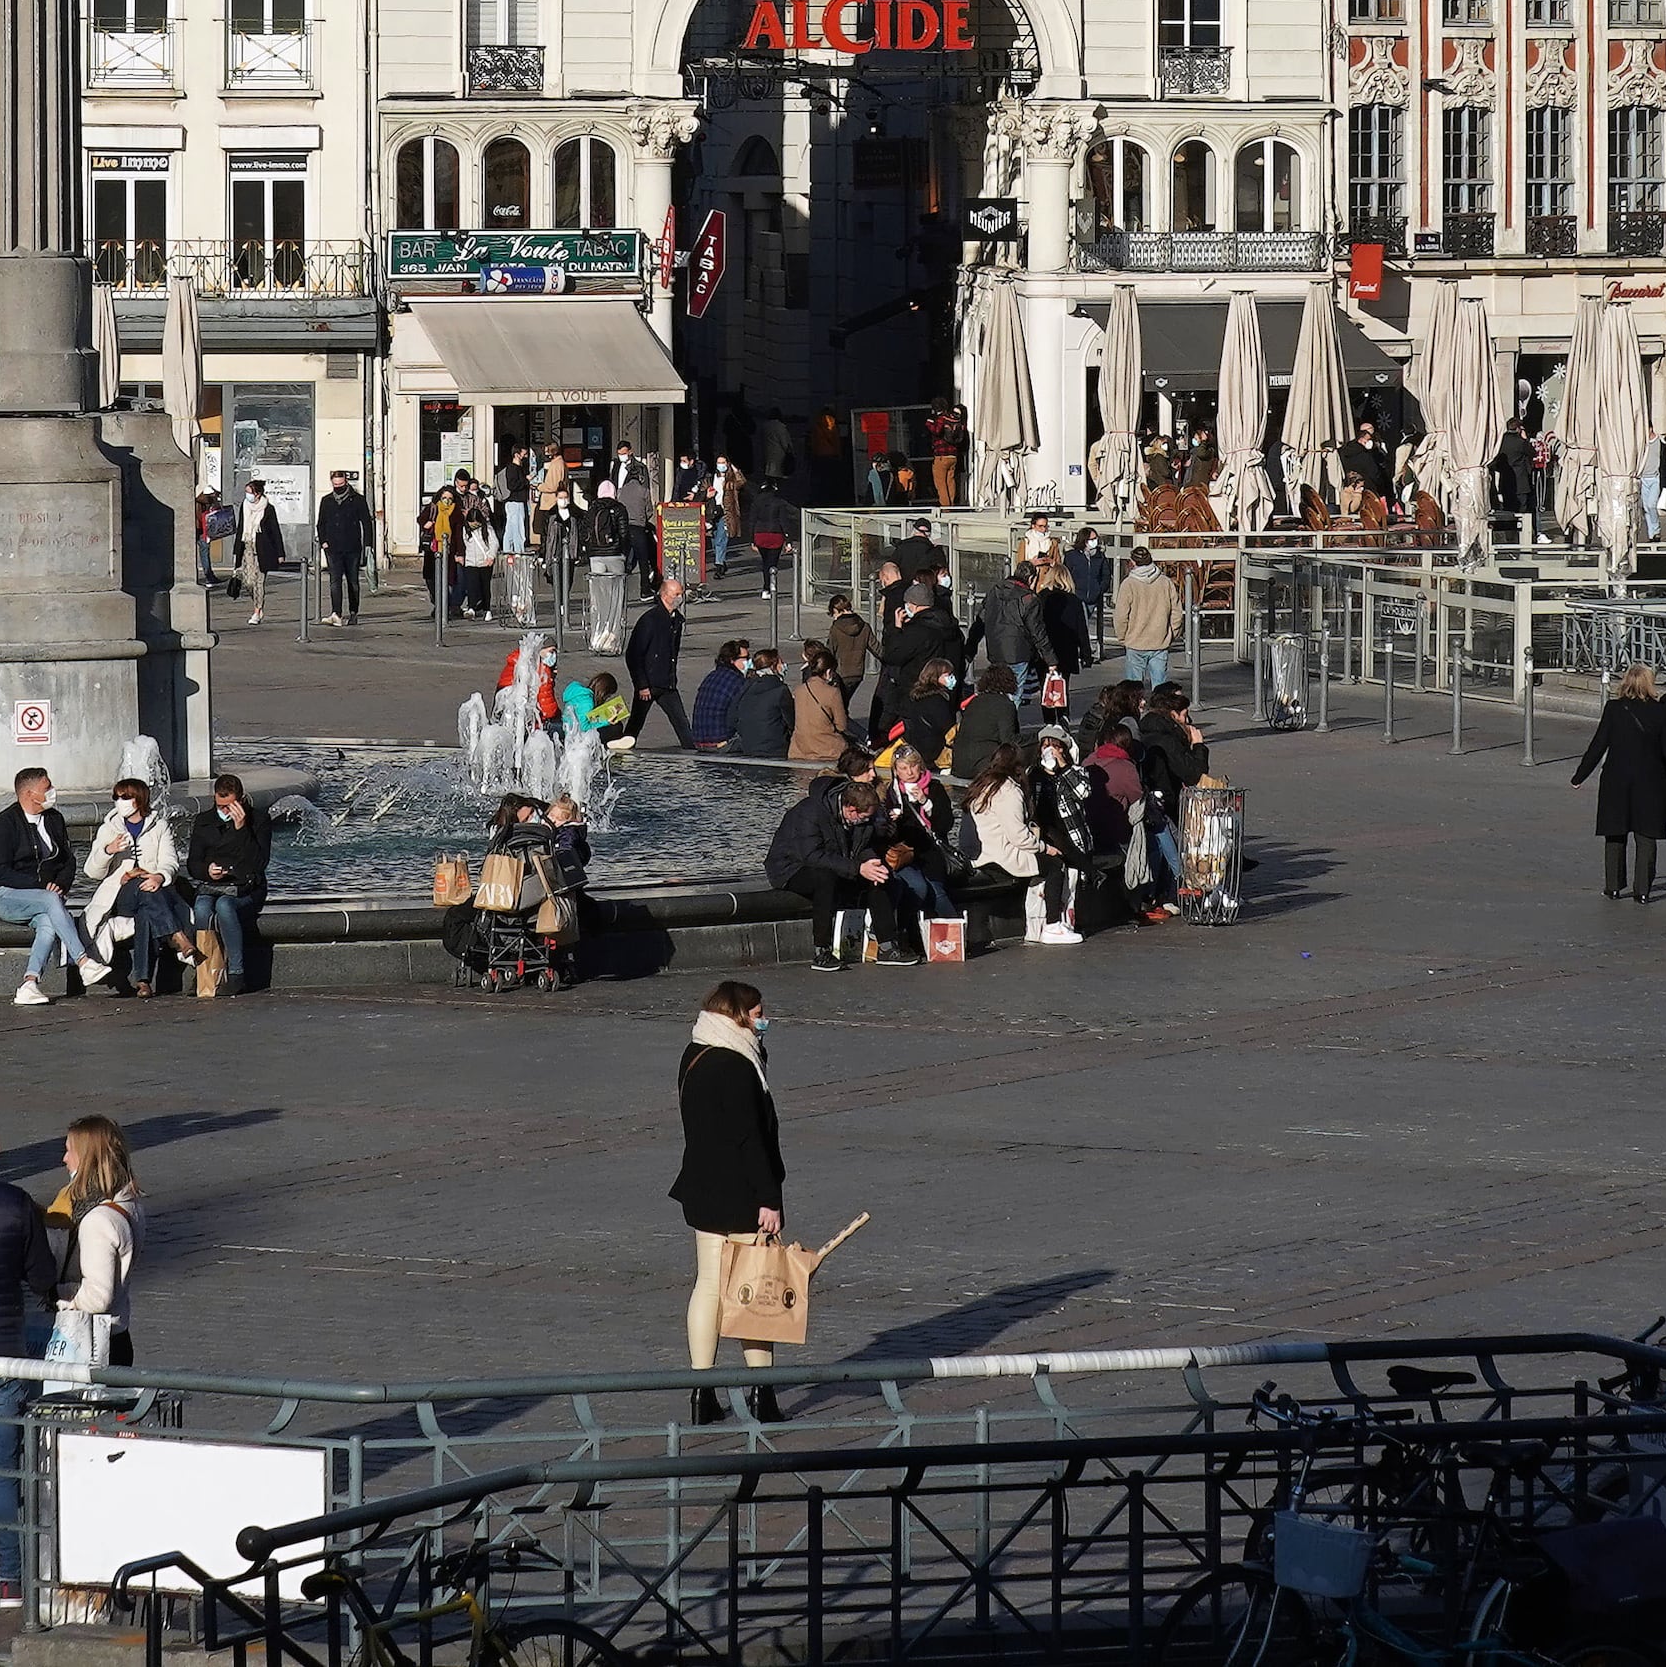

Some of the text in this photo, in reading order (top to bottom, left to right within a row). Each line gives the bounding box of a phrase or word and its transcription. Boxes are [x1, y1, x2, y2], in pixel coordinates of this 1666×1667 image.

[92, 156, 119, 168] Live
[969, 209, 1011, 234] MEUNIER
[399, 235, 629, 262] BAR La Voute TABAC
[399, 263, 428, 273] 365
[568, 262, 587, 272] DU
[590, 262, 630, 271] MATIN
[696, 235, 718, 295] TABAC
[1607, 281, 1666, 300] Baccarat
[536, 391, 608, 403] LA VOUTE
